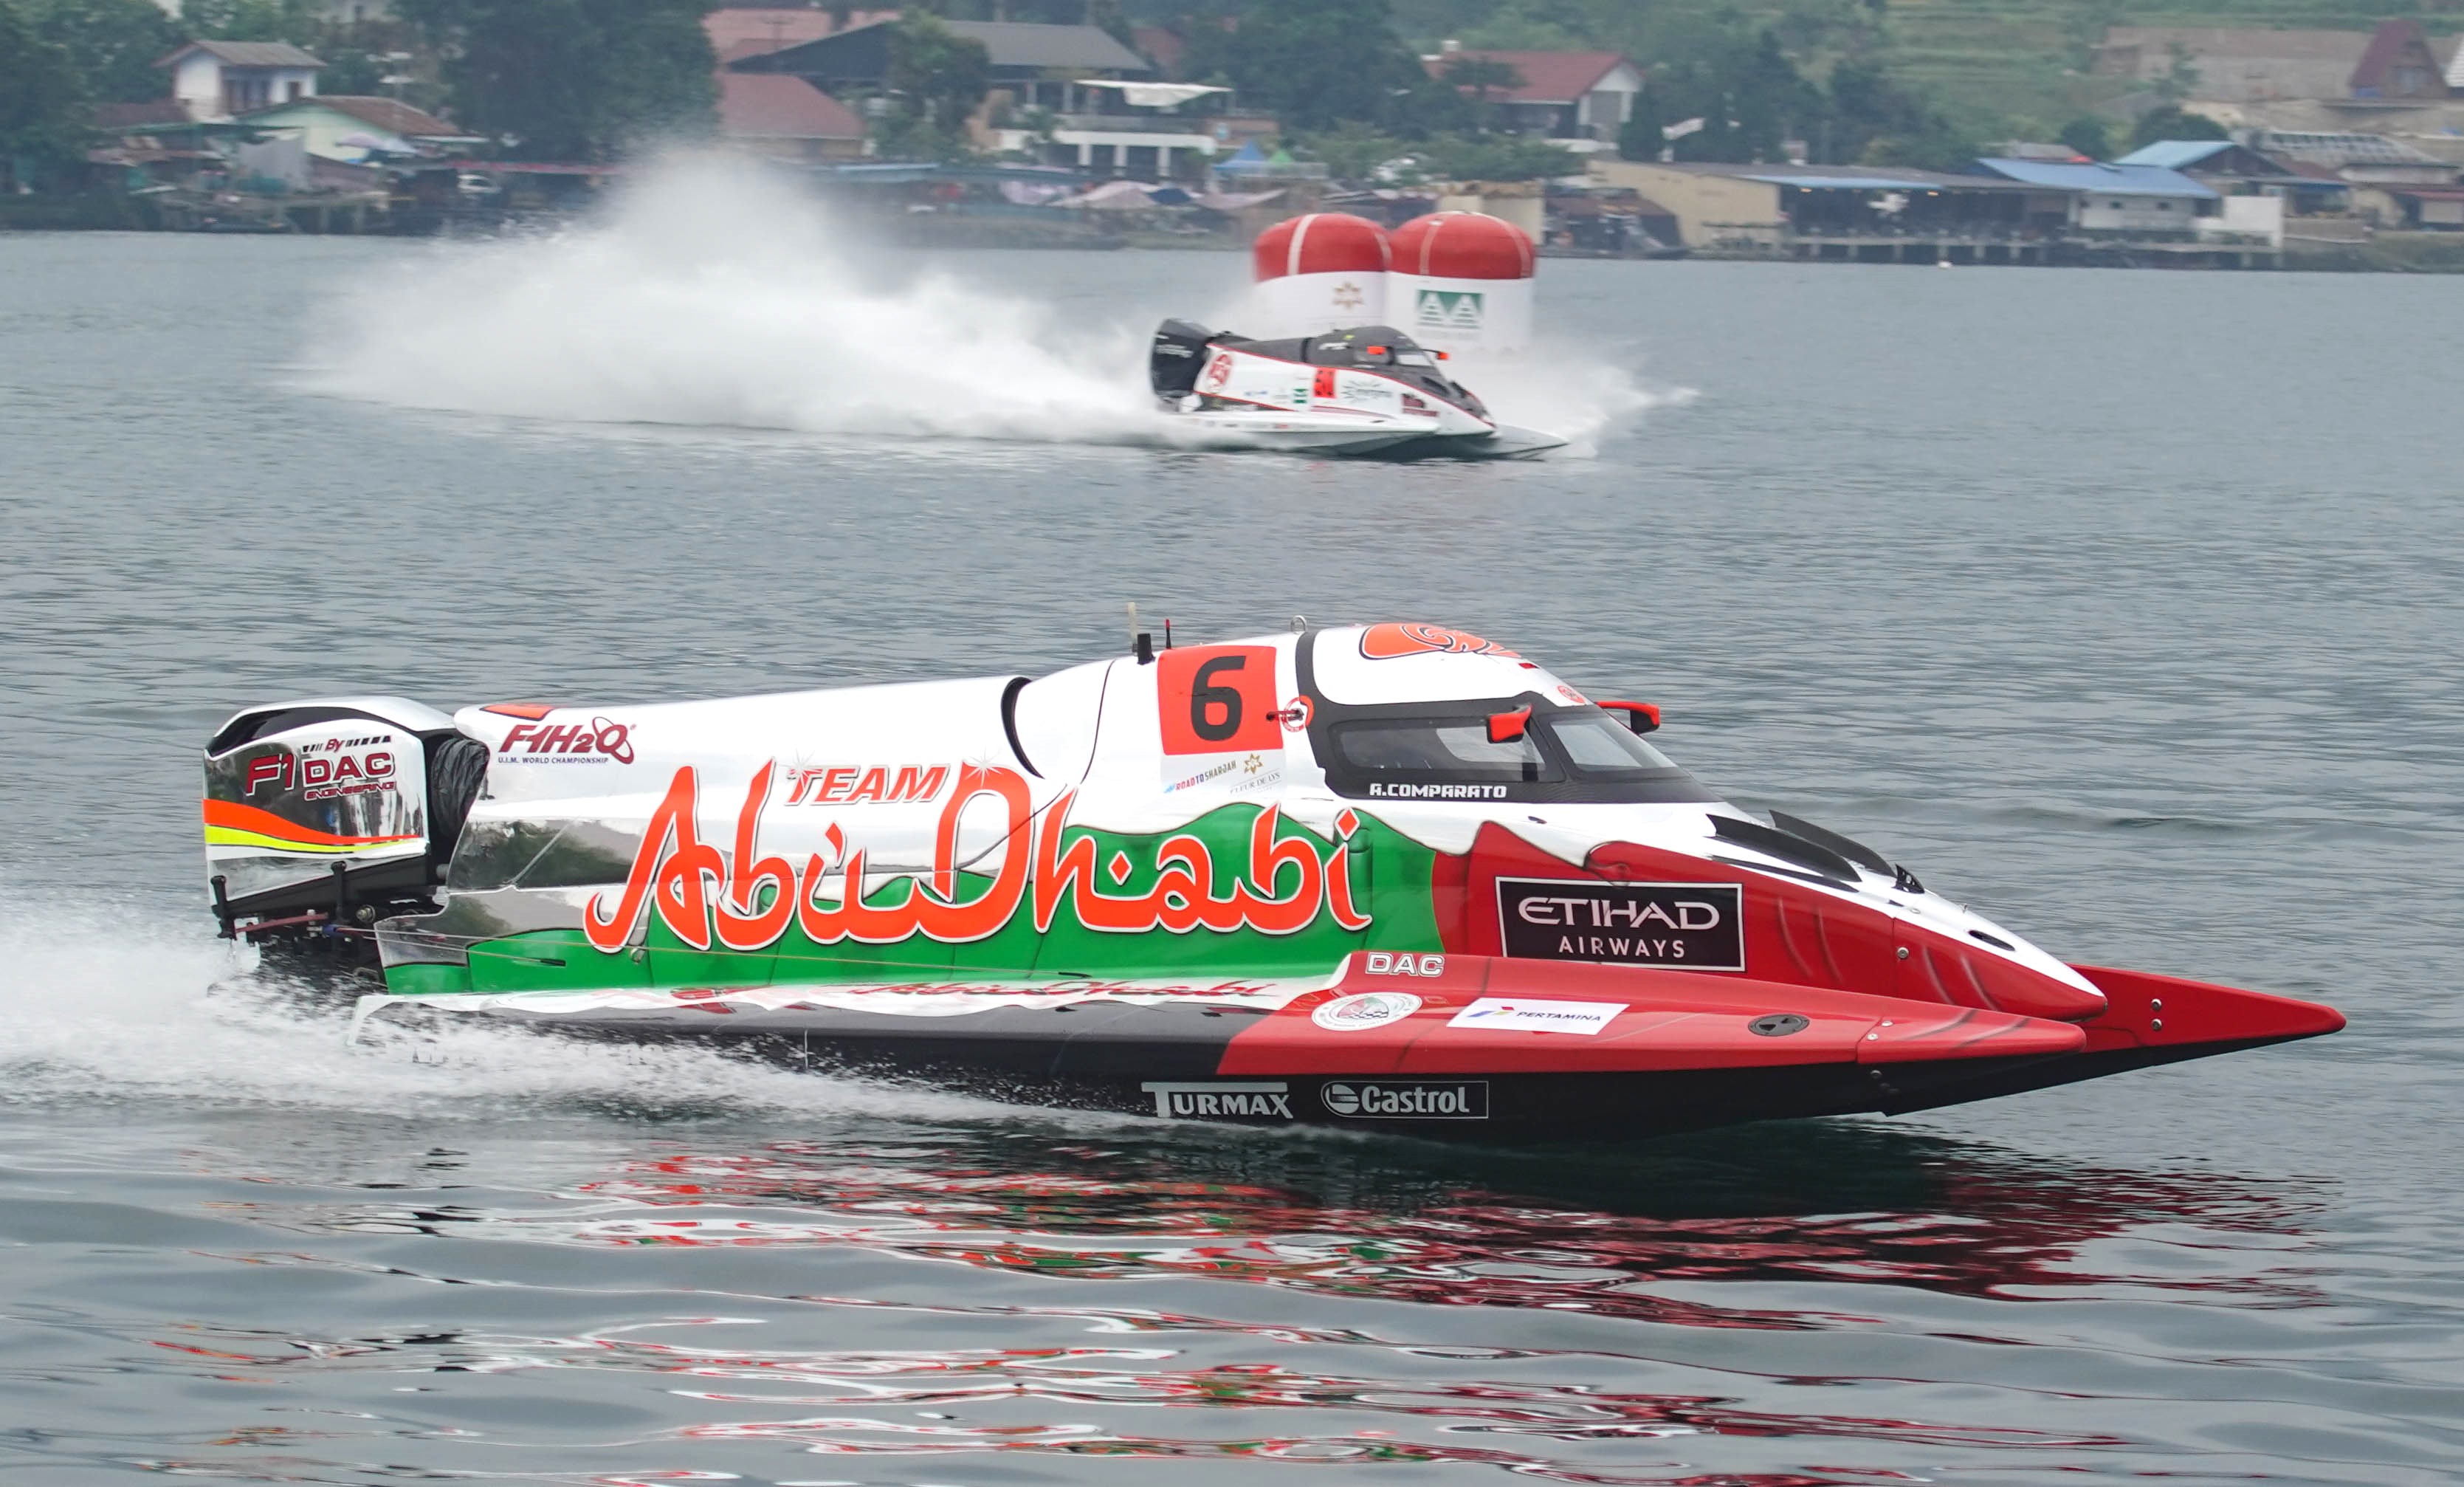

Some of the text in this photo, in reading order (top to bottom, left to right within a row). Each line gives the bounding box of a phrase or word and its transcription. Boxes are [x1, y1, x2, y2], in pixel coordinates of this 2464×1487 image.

[1190, 655, 1246, 741] 6
[325, 738, 344, 752] By
[246, 753, 297, 796] F1
[302, 752, 396, 787] DAC
[784, 763, 951, 806] TEAM
[305, 780, 396, 801] ENGINEERING
[1369, 783, 1507, 797] A.COMPARATO
[582, 755, 1373, 954] Abu Dhabi
[1518, 896, 1721, 930] ETIHAD
[1558, 935, 1685, 958] AIRWAYS
[1365, 952, 1445, 977] DAC
[1515, 1011, 1602, 1023] PERTAMINA
[1141, 1082, 1293, 1119] TURMAX
[1361, 1085, 1470, 1114] Castrol
